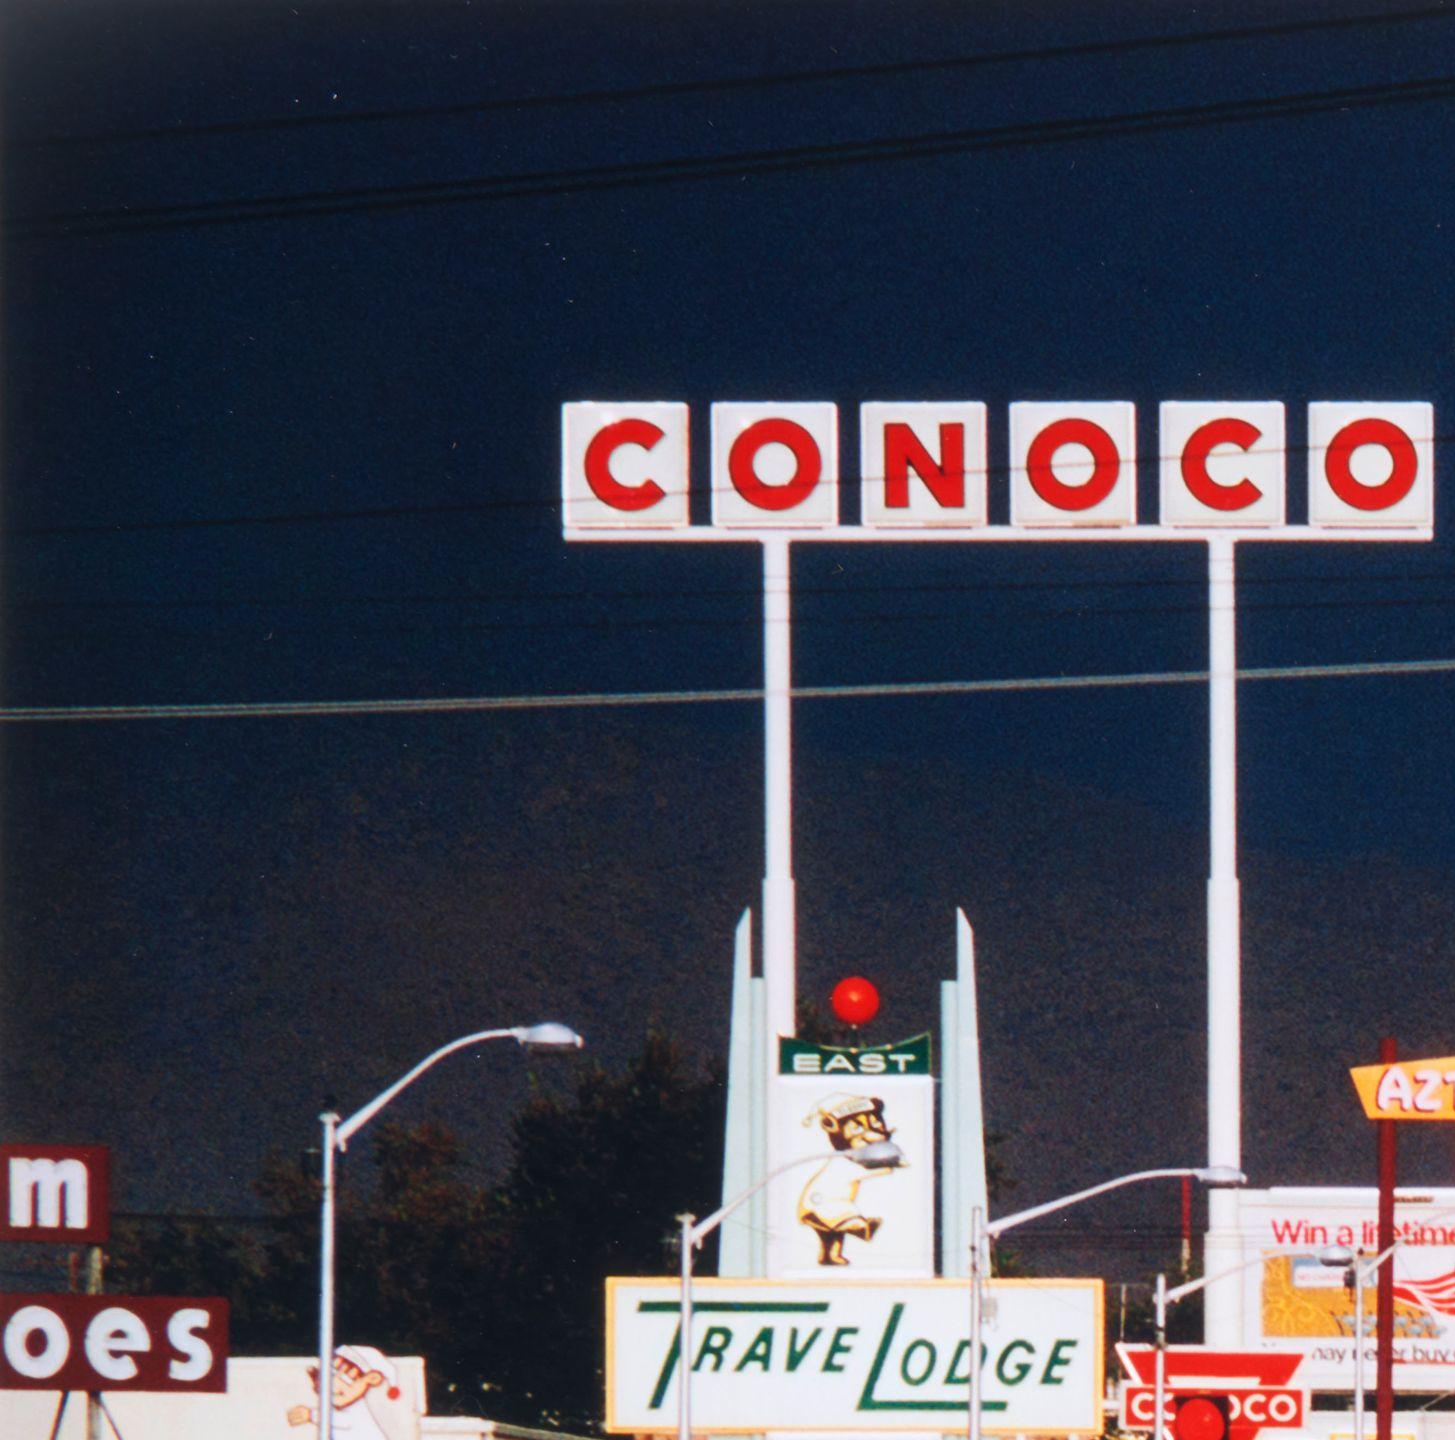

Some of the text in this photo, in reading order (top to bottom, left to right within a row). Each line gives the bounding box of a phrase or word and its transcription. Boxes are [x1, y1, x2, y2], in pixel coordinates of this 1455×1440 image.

[584, 417, 1419, 511] CONOCO
[792, 1052, 916, 1073] EAST
[1271, 1219, 1328, 1245] Win
